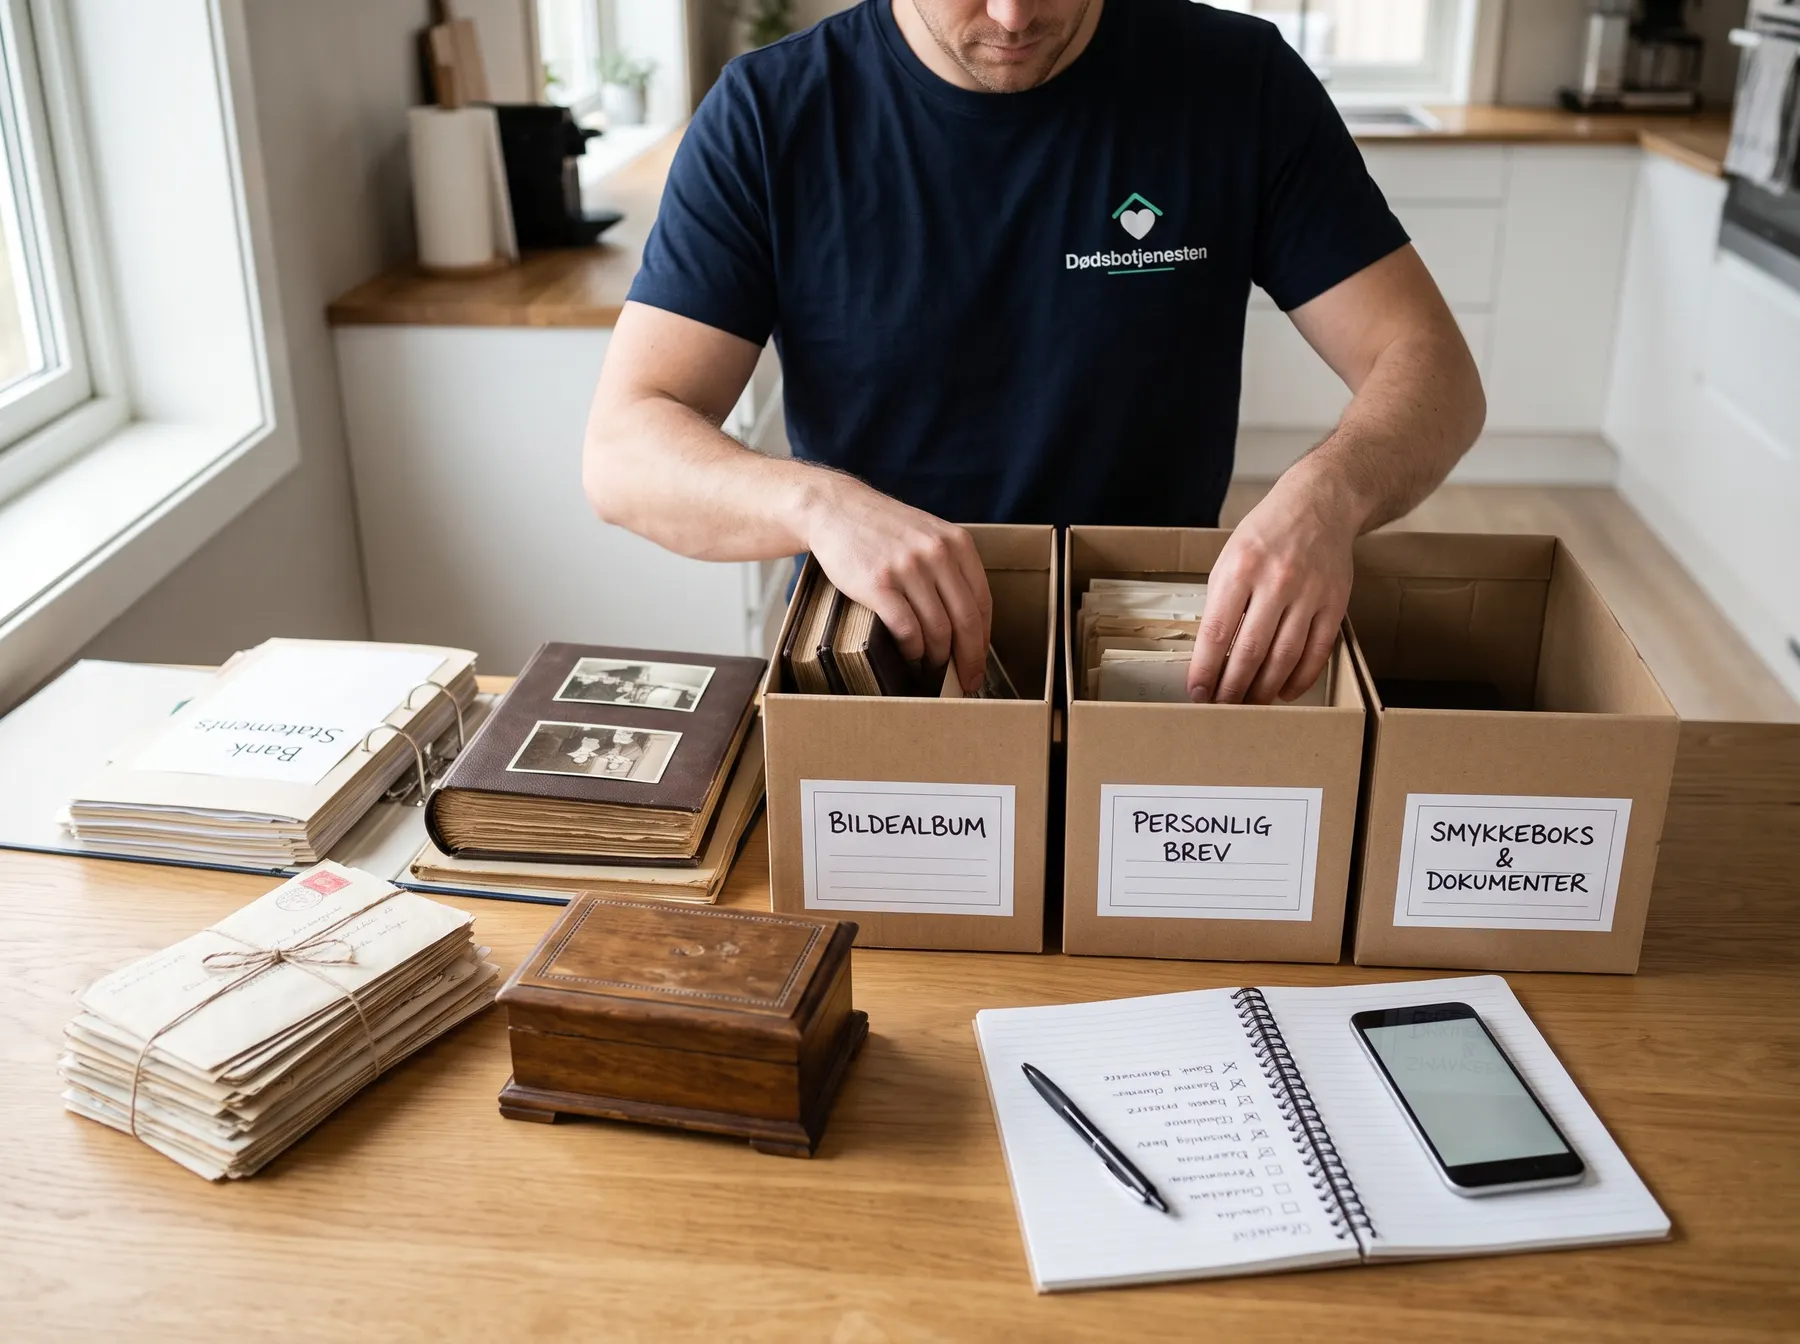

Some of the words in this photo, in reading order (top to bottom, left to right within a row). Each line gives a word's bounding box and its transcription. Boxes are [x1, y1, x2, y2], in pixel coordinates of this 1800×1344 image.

[1065, 246, 1208, 269] Dødsbotjenesten
[194, 720, 344, 743] Statements
[227, 742, 303, 762] Bank
[828, 810, 986, 838] BILDEALBUM
[1132, 811, 1272, 837] PERSONLIG
[1430, 821, 1595, 847] SMYKKEBOKS
[1163, 841, 1231, 862] BREV
[1495, 847, 1514, 868] &
[1426, 871, 1588, 893] DOKUMENTER
